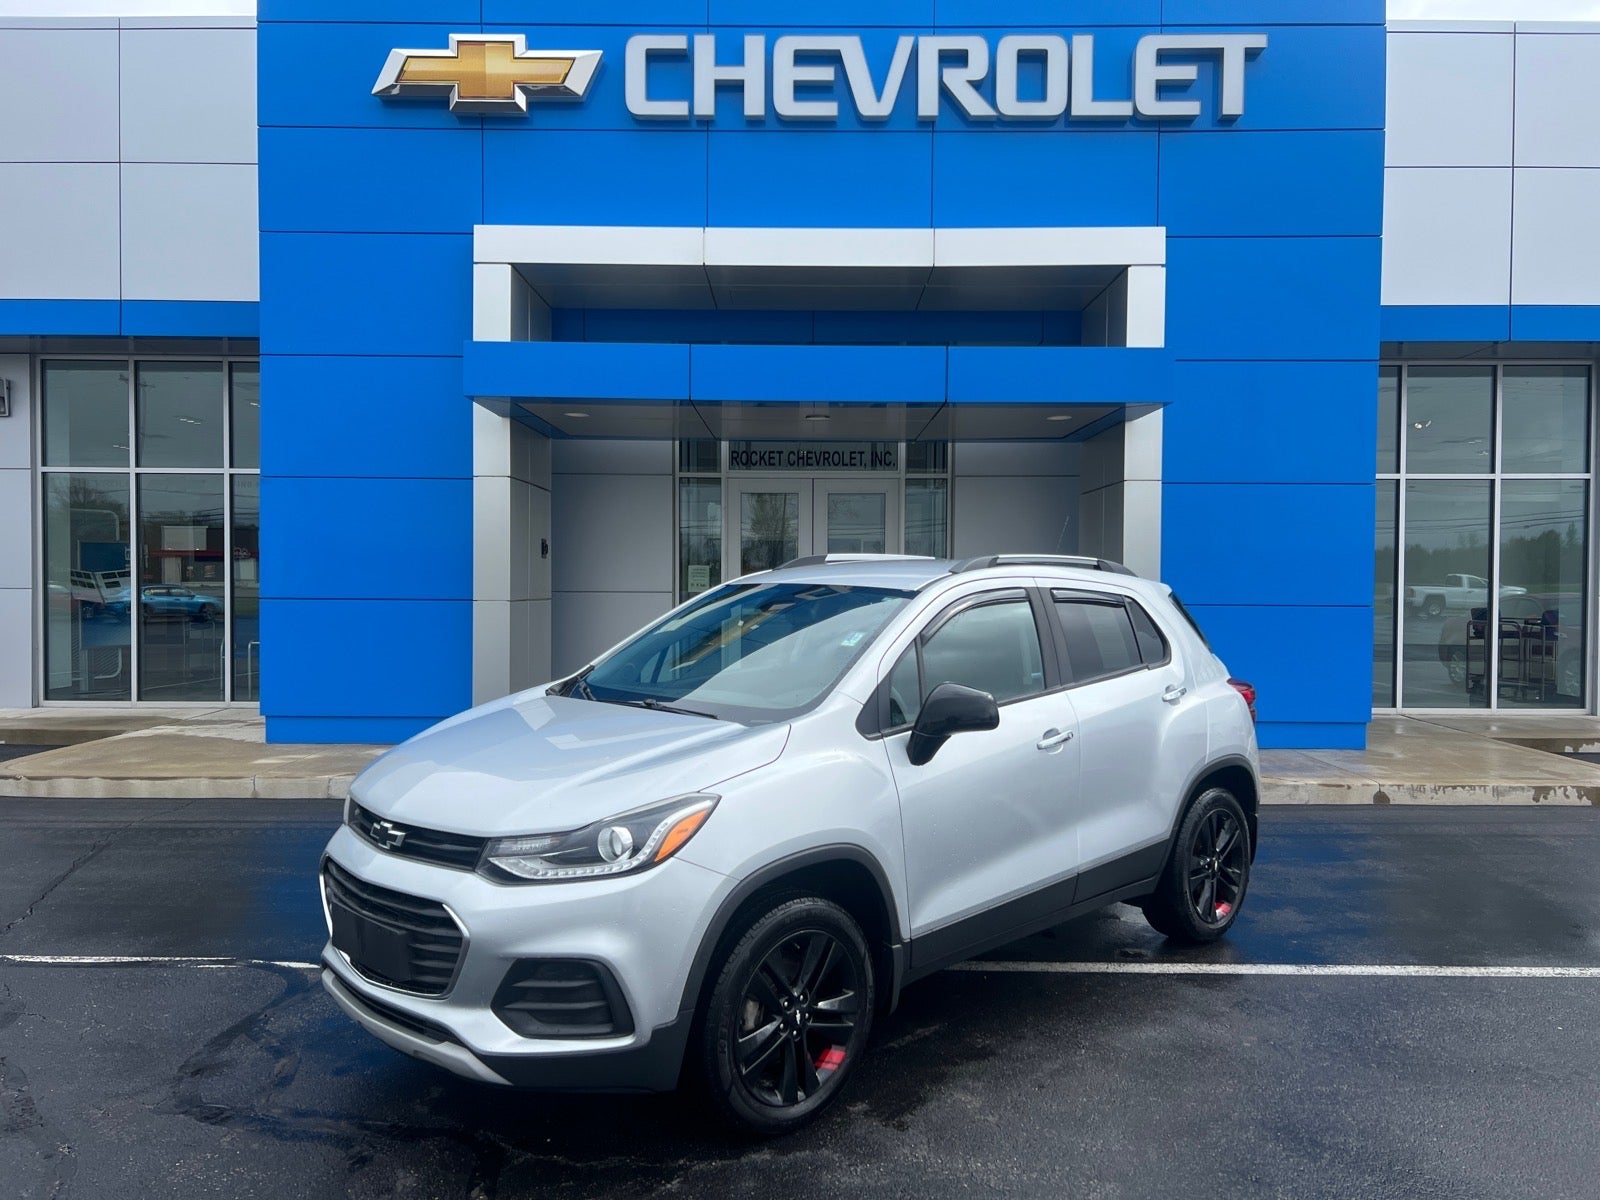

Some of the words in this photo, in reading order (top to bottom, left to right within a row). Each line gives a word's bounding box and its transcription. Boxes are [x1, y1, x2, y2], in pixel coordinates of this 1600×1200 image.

[624, 33, 1268, 118] CHEVROLET
[730, 450, 784, 467] ROCKET
[787, 450, 867, 469] CHEVROLET,
[870, 450, 896, 467] INC.
